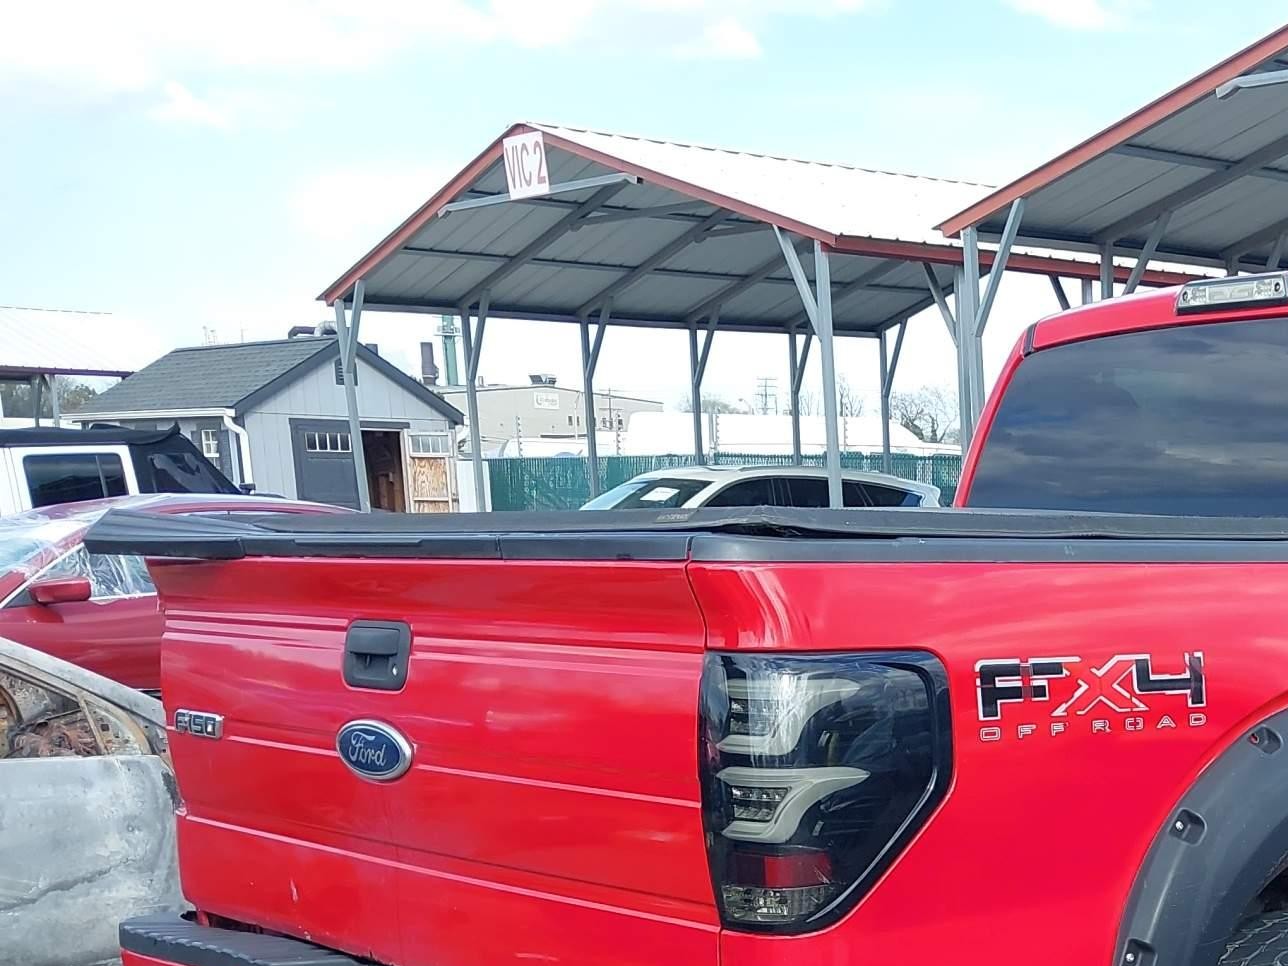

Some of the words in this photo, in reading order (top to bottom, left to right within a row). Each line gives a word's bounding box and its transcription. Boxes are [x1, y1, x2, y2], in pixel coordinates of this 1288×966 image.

[974, 651, 1207, 721] FX4
[979, 722, 1069, 742] OFF
[1092, 712, 1207, 734] ROAD
[348, 731, 387, 767] Ford
